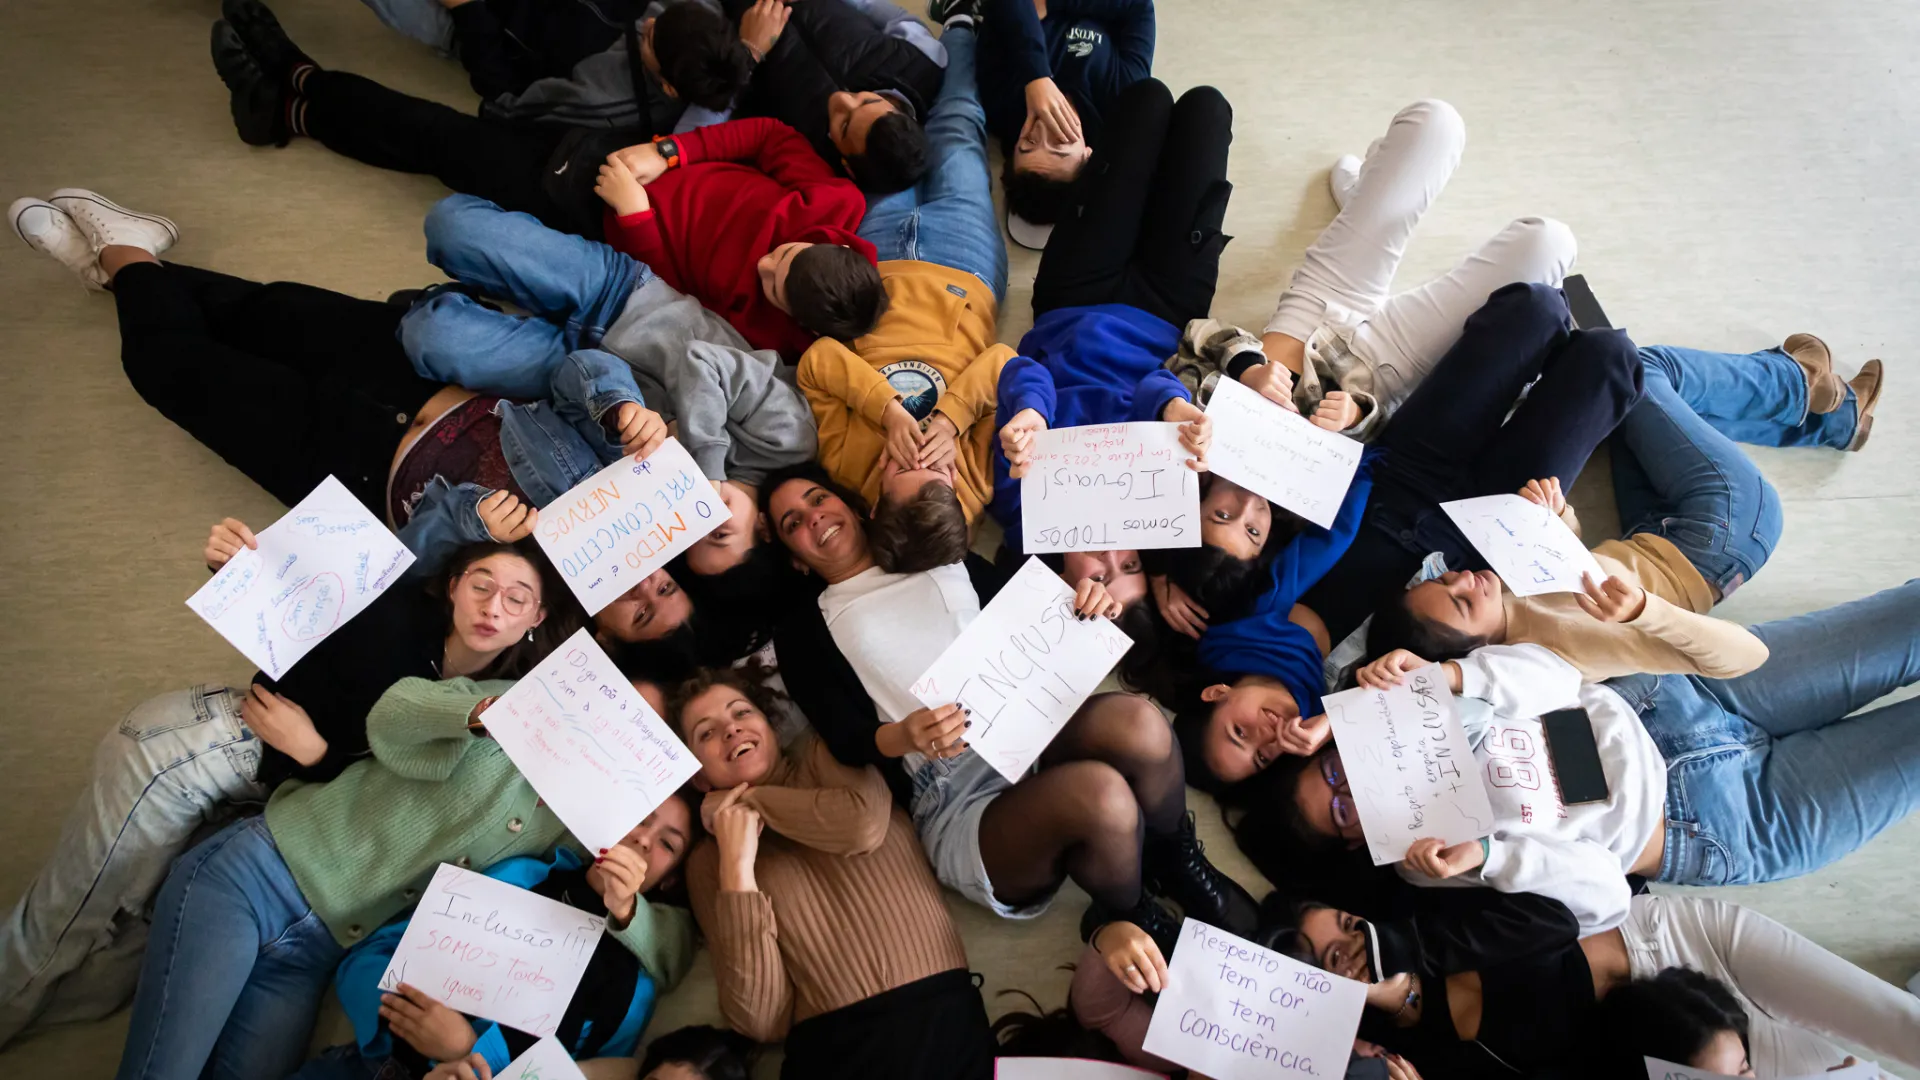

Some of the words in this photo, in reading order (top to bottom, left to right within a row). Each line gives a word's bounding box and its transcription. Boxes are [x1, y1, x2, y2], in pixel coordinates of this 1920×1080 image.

[1066, 27, 1102, 44] LACOST
[632, 460, 651, 475] dos
[1063, 453, 1102, 467] 2023
[542, 480, 621, 543] NERVOS
[695, 500, 711, 518] O
[625, 511, 687, 569] MEDO
[1482, 726, 1540, 790] 86
[433, 892, 553, 948] Inclusão
[1192, 923, 1279, 974] Respeito
[1295, 970, 1332, 994] não
[1218, 962, 1258, 993] tem
[1229, 998, 1276, 1032] tem
